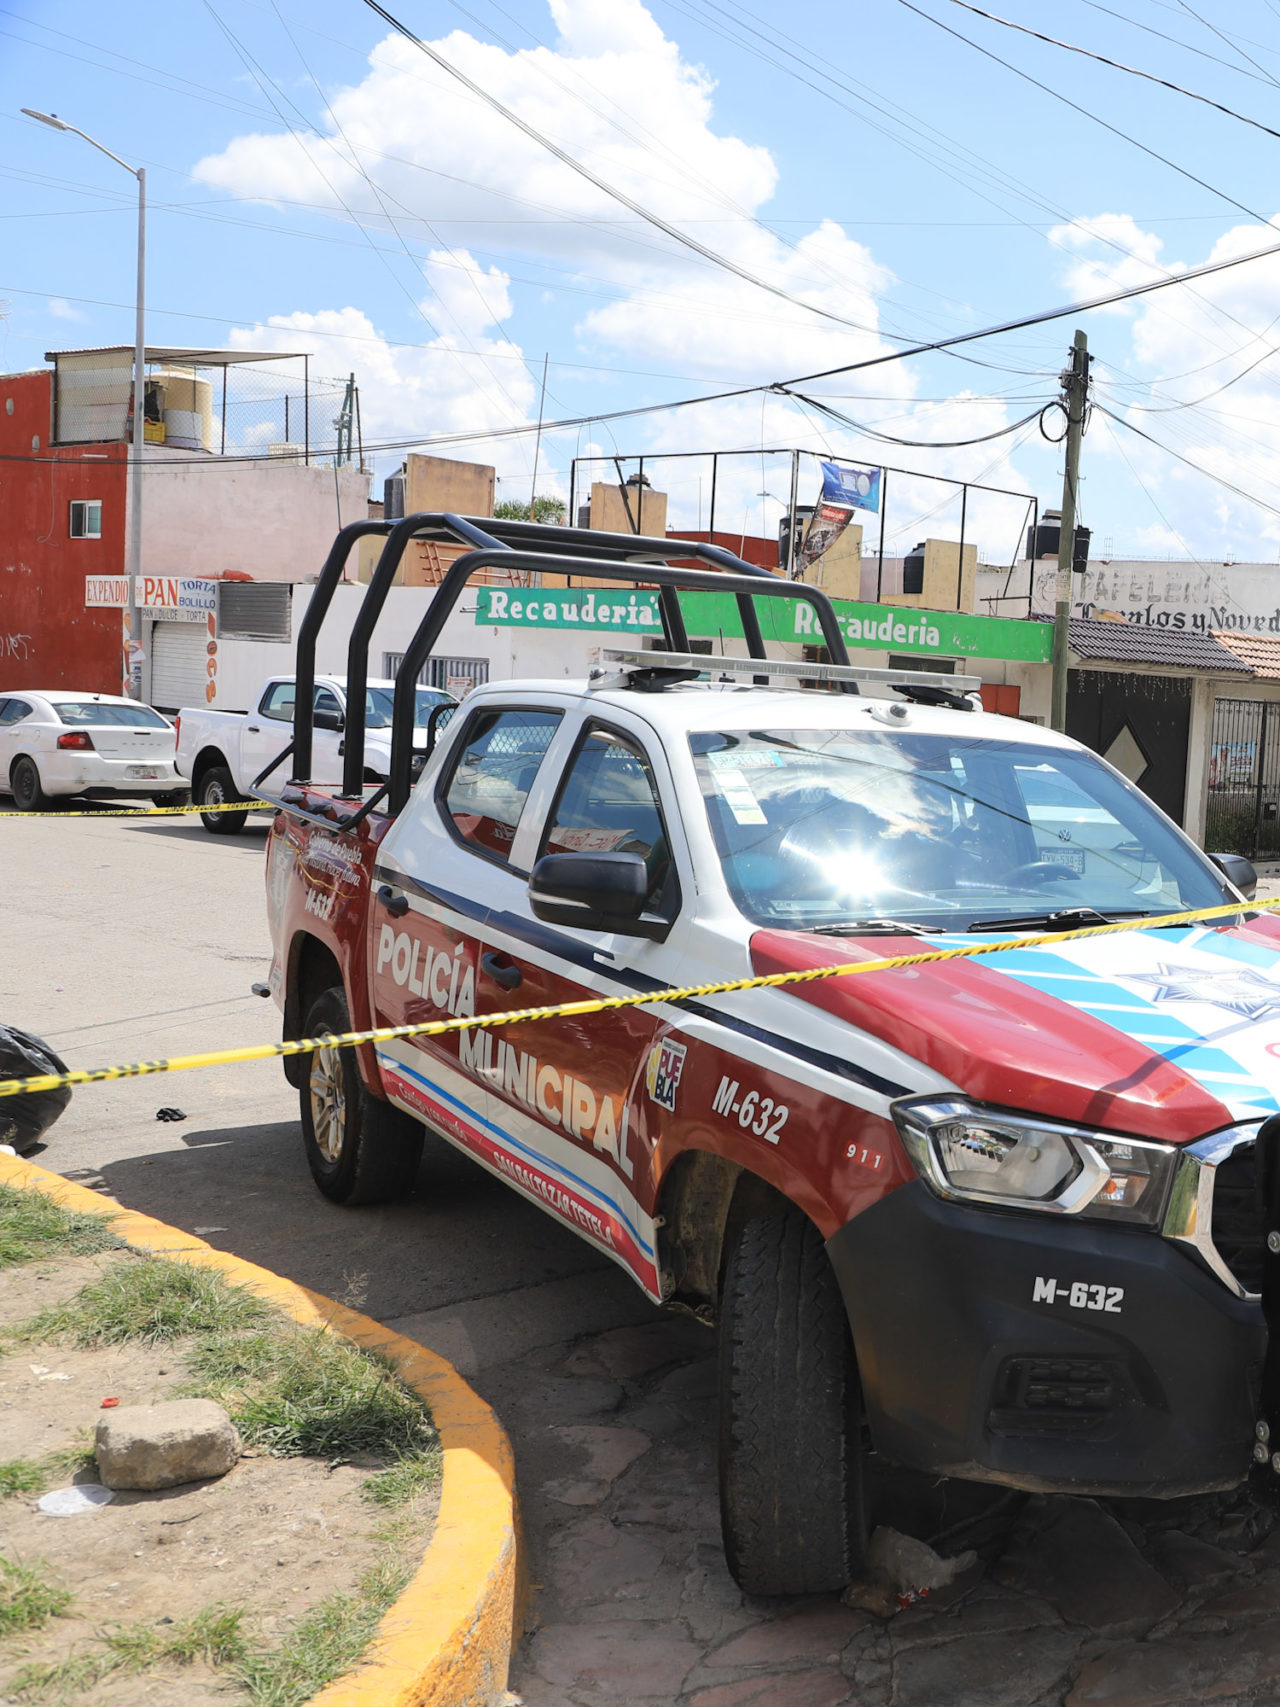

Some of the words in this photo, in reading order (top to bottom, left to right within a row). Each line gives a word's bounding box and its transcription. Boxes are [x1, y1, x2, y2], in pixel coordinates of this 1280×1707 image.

[87, 580, 129, 602] EXPENDIO
[143, 577, 178, 606] PAN
[179, 596, 216, 609] BOLILLO
[180, 580, 216, 595] TORTA
[142, 608, 154, 620] PAN
[158, 609, 179, 621] DULCE
[186, 610, 206, 622] TORTA
[305, 888, 332, 921] M-632
[377, 923, 475, 1024] POLICÍA
[459, 1027, 634, 1181] MUNICIPAL
[711, 1075, 790, 1146] M-632
[493, 1150, 515, 1177] SAN
[514, 1161, 570, 1217] BALTAZAR
[569, 1199, 617, 1249] TETELA
[1032, 1276, 1125, 1313] M-632
